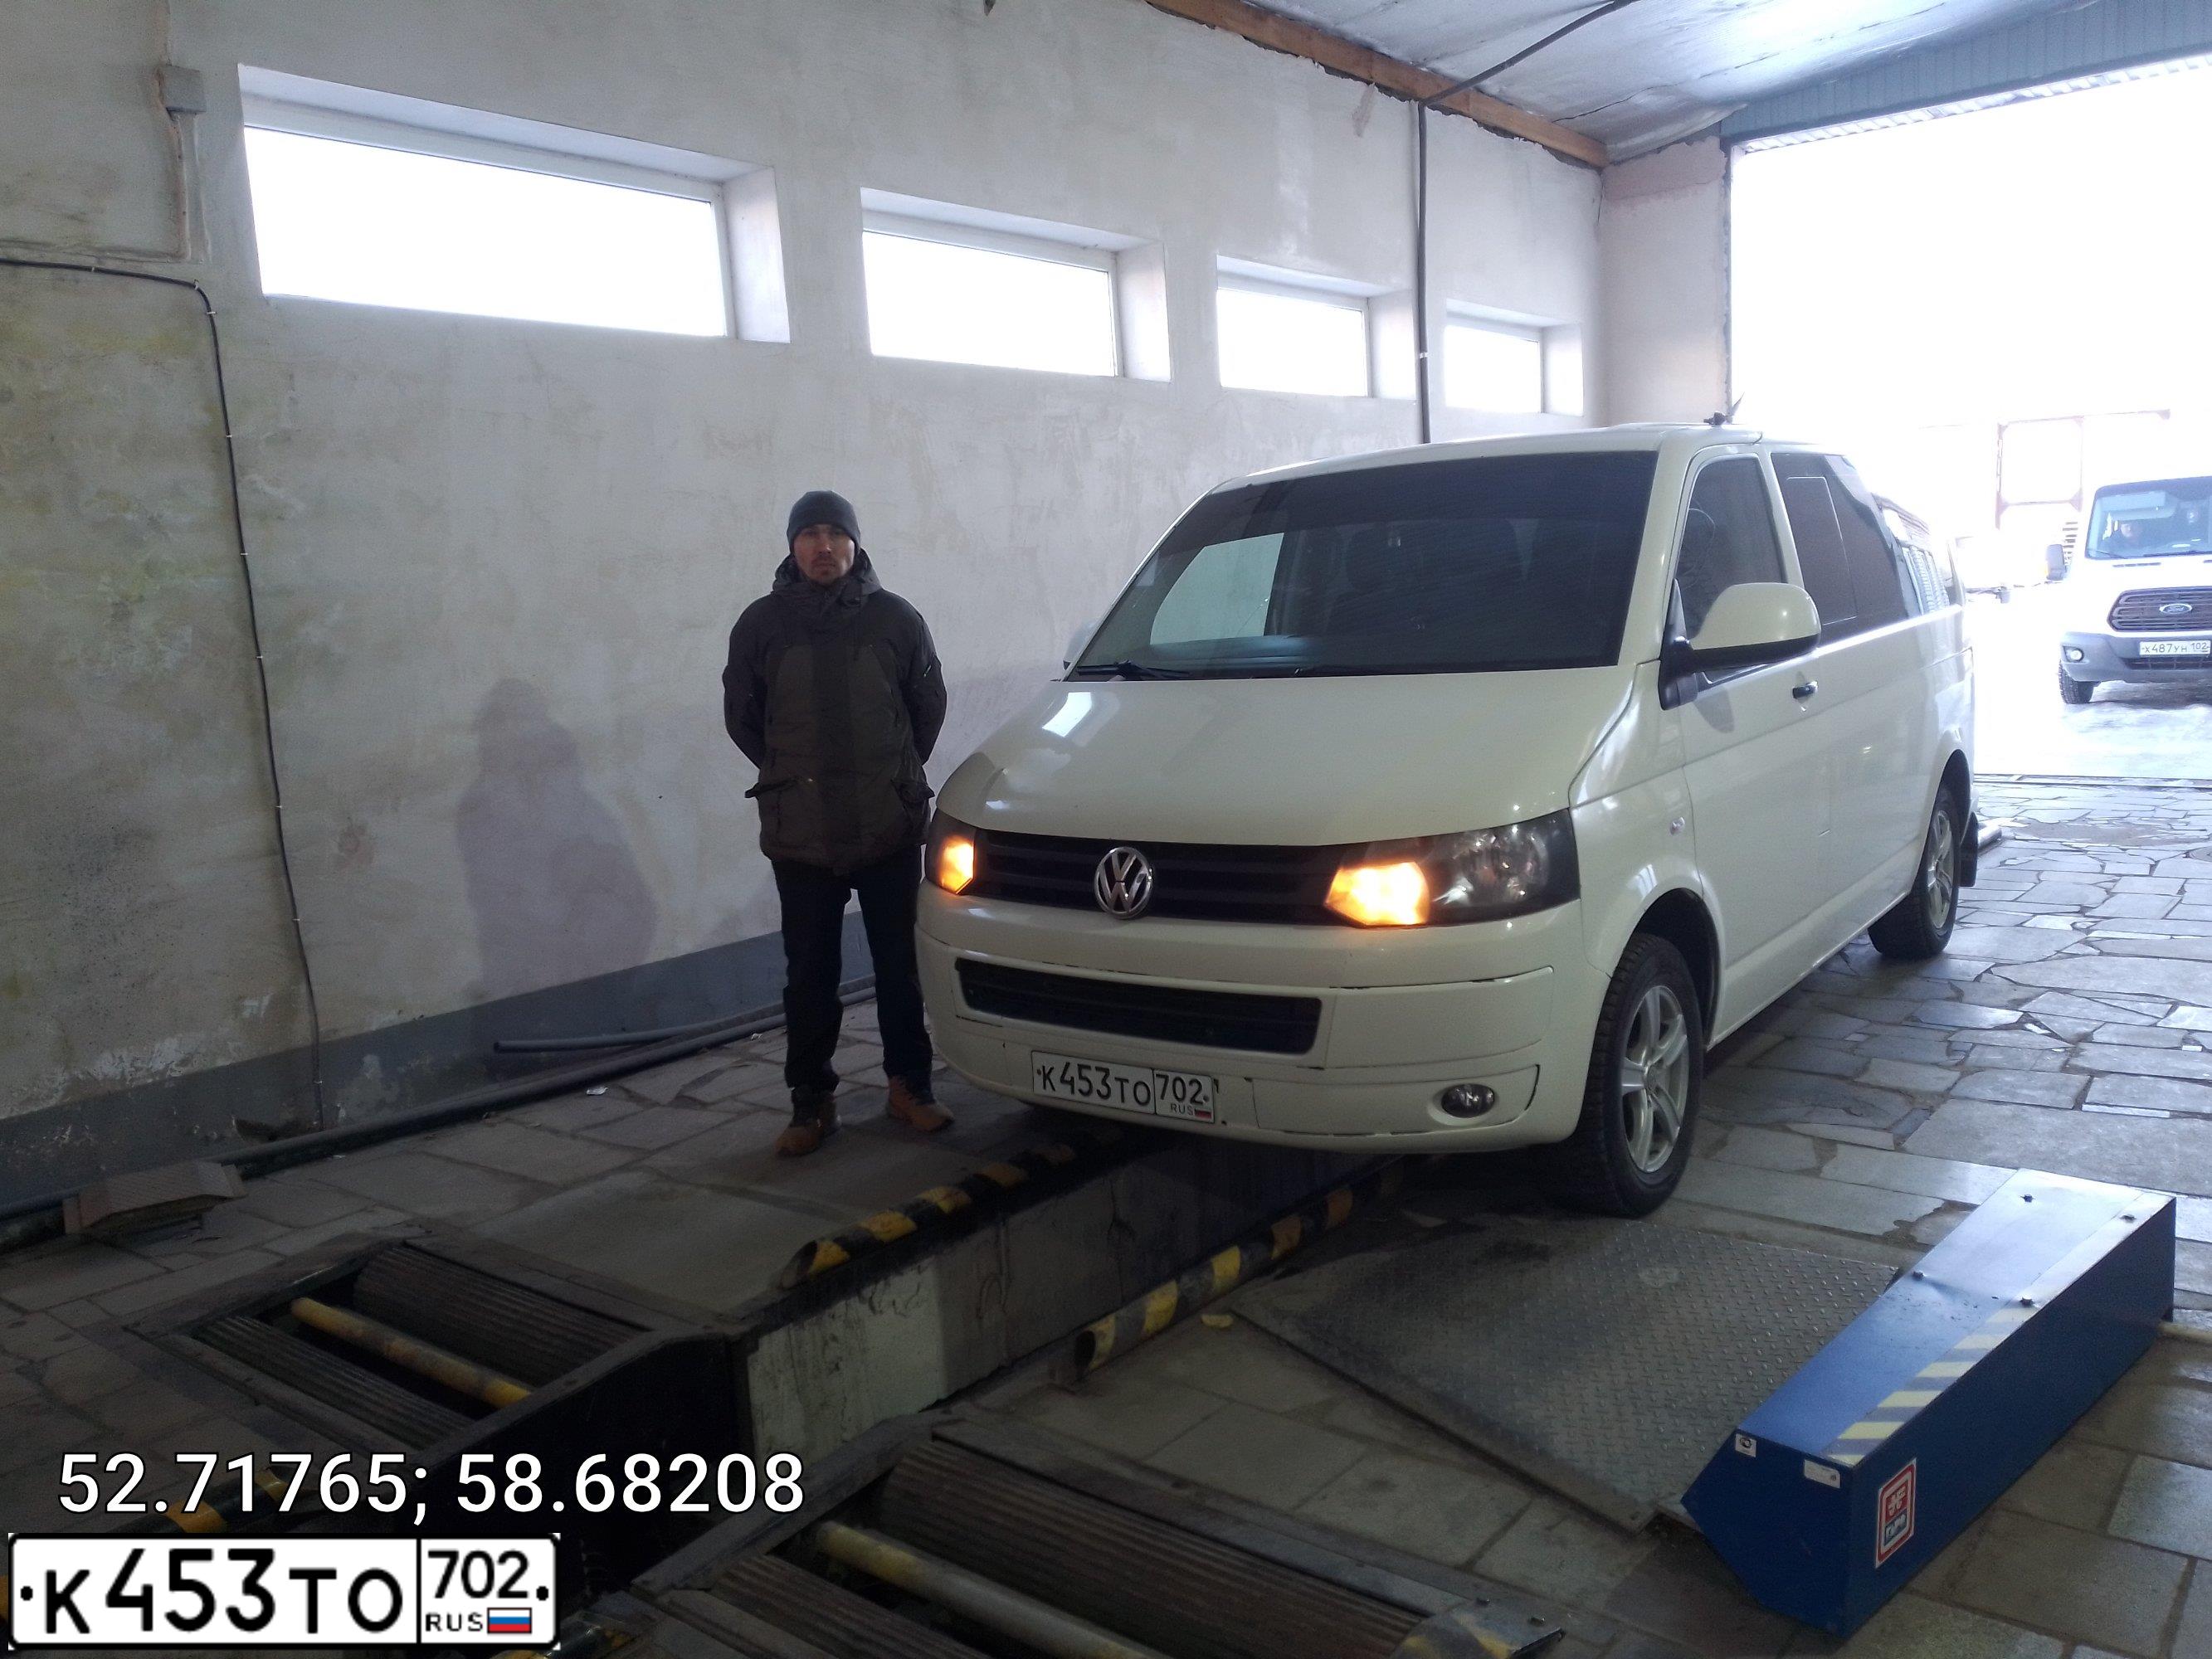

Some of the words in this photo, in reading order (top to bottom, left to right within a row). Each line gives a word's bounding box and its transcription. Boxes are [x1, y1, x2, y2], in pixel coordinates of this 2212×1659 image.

[1041, 1061, 1151, 1107] К453ТО
[1156, 1073, 1203, 1104] 702
[1171, 1102, 1193, 1117] RUS
